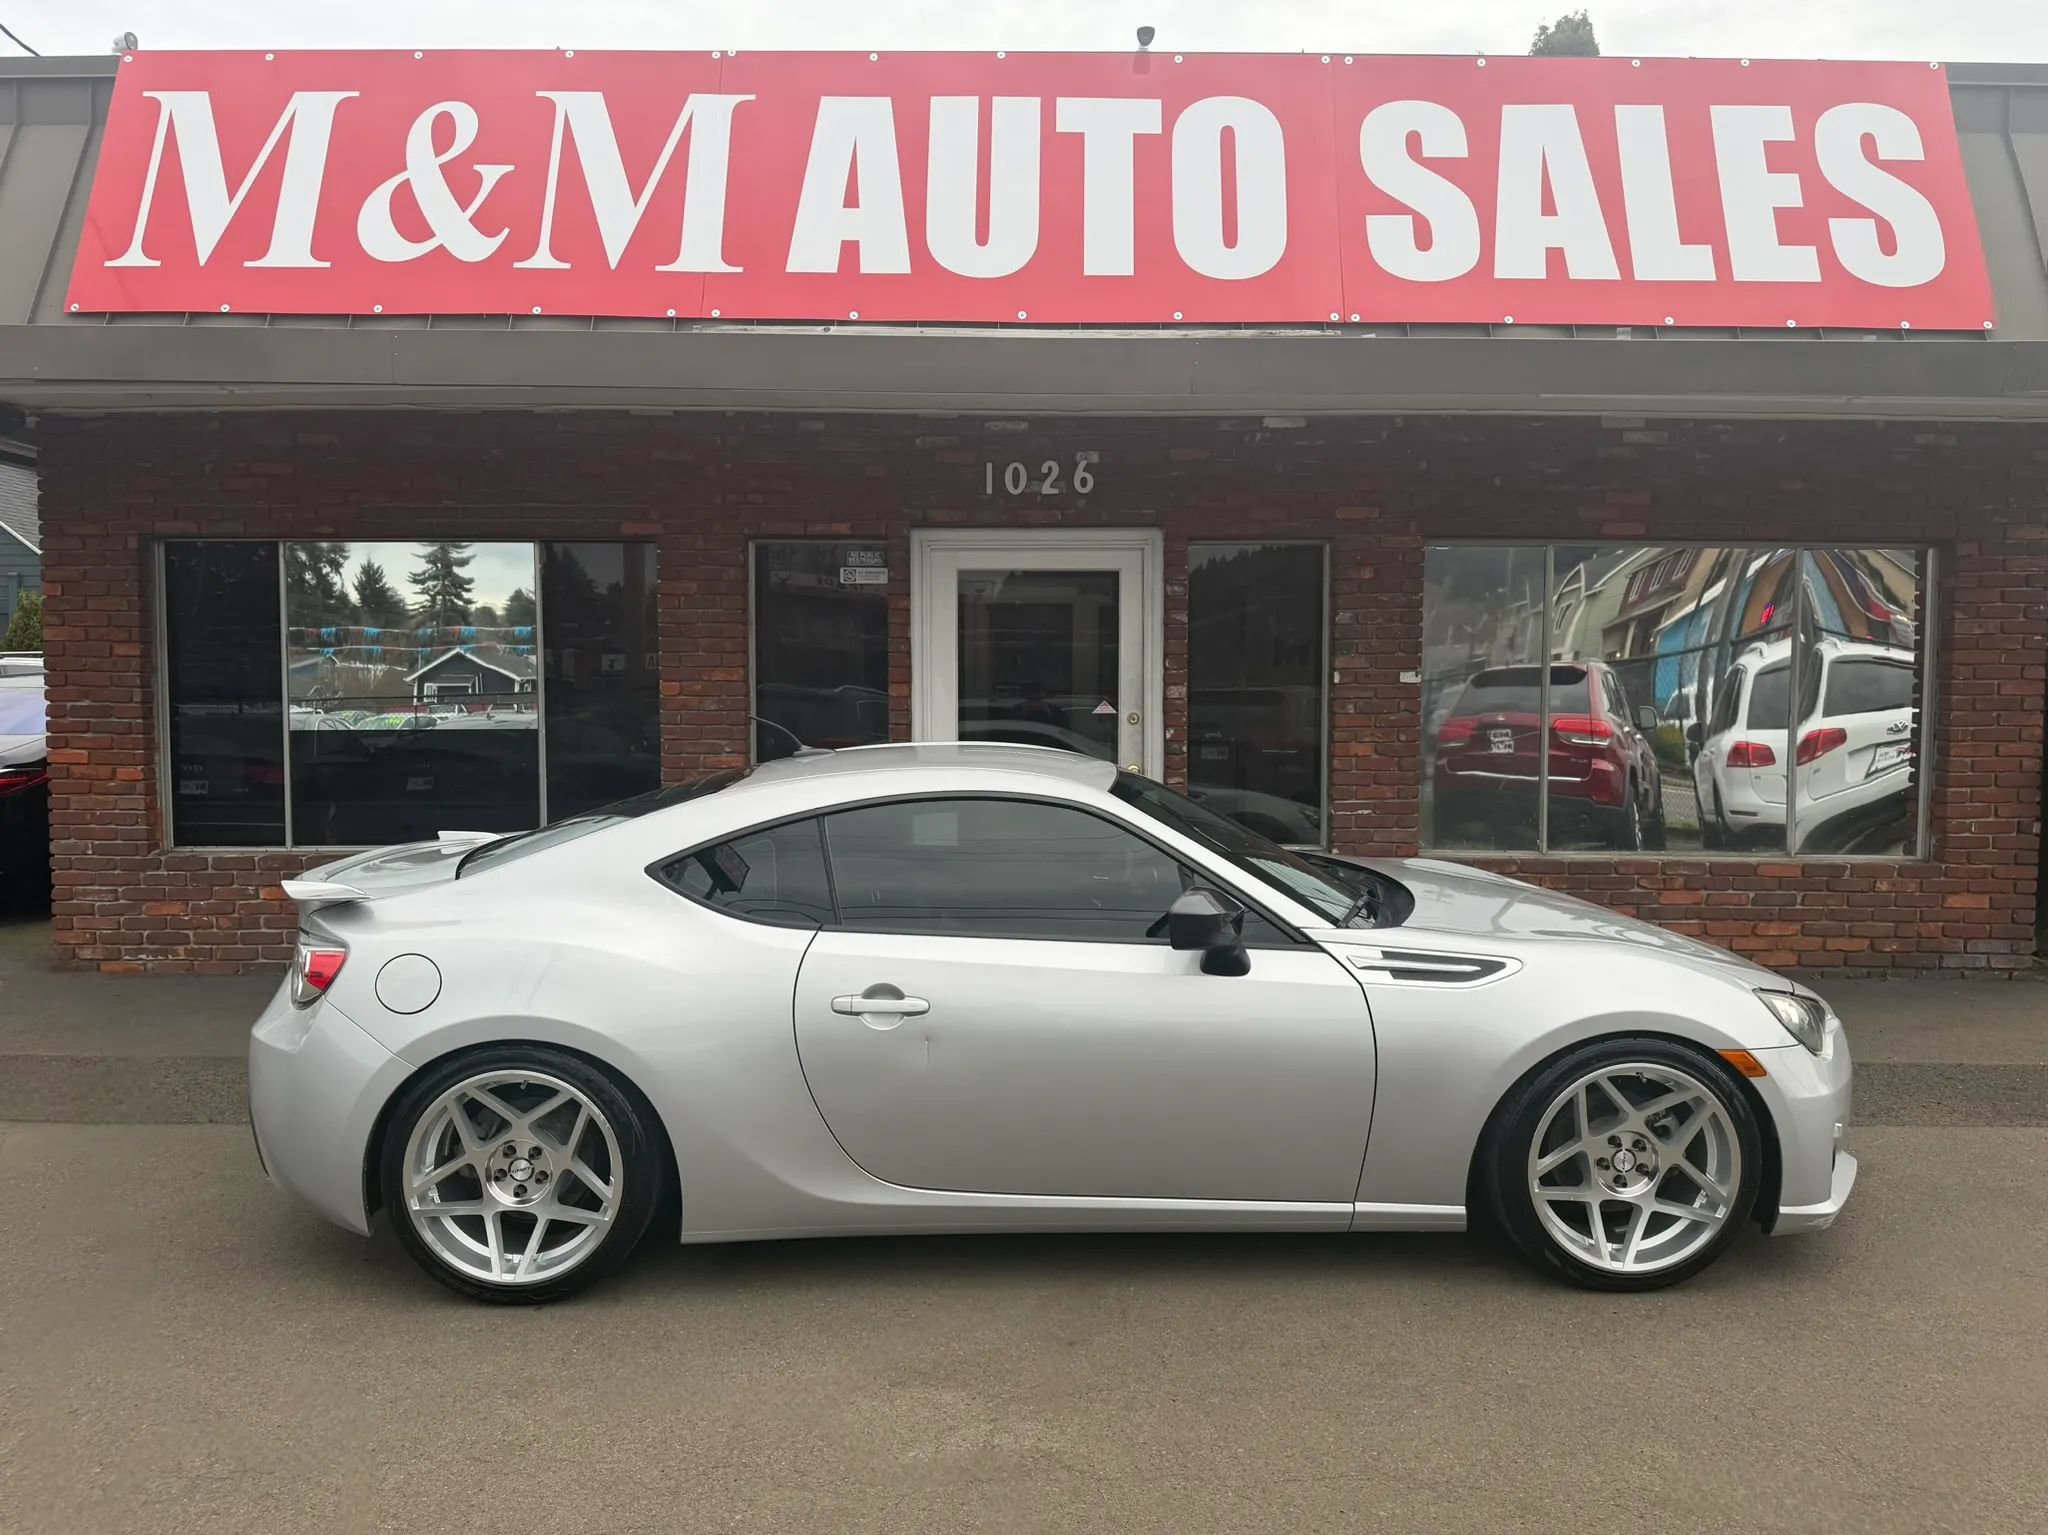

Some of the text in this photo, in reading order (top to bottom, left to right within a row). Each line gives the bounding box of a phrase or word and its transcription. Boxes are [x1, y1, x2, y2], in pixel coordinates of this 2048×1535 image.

[104, 91, 1946, 288] M&M AUTO SALES
[986, 460, 1094, 495] 1026
